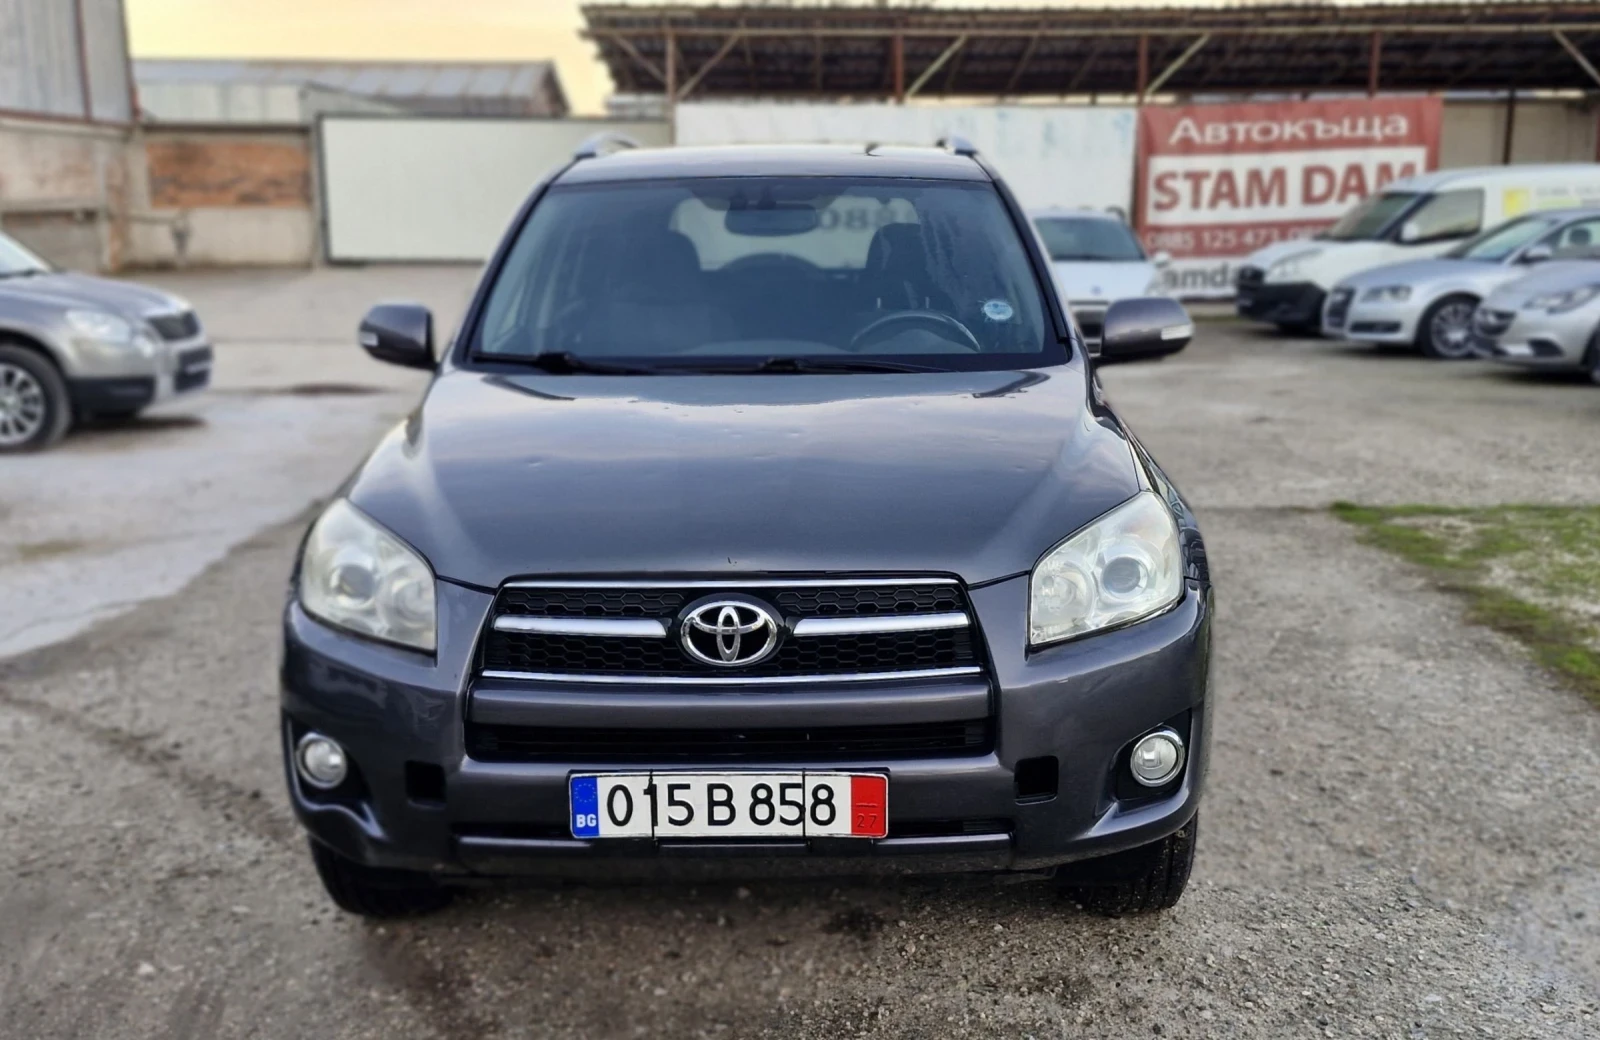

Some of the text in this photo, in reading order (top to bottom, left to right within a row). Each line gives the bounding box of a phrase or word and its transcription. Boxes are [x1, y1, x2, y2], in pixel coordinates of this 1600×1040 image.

[1168, 113, 1409, 146] Автокъща
[1152, 166, 1287, 212] STAM
[575, 813, 597, 828] BG
[856, 812, 878, 829] 27
